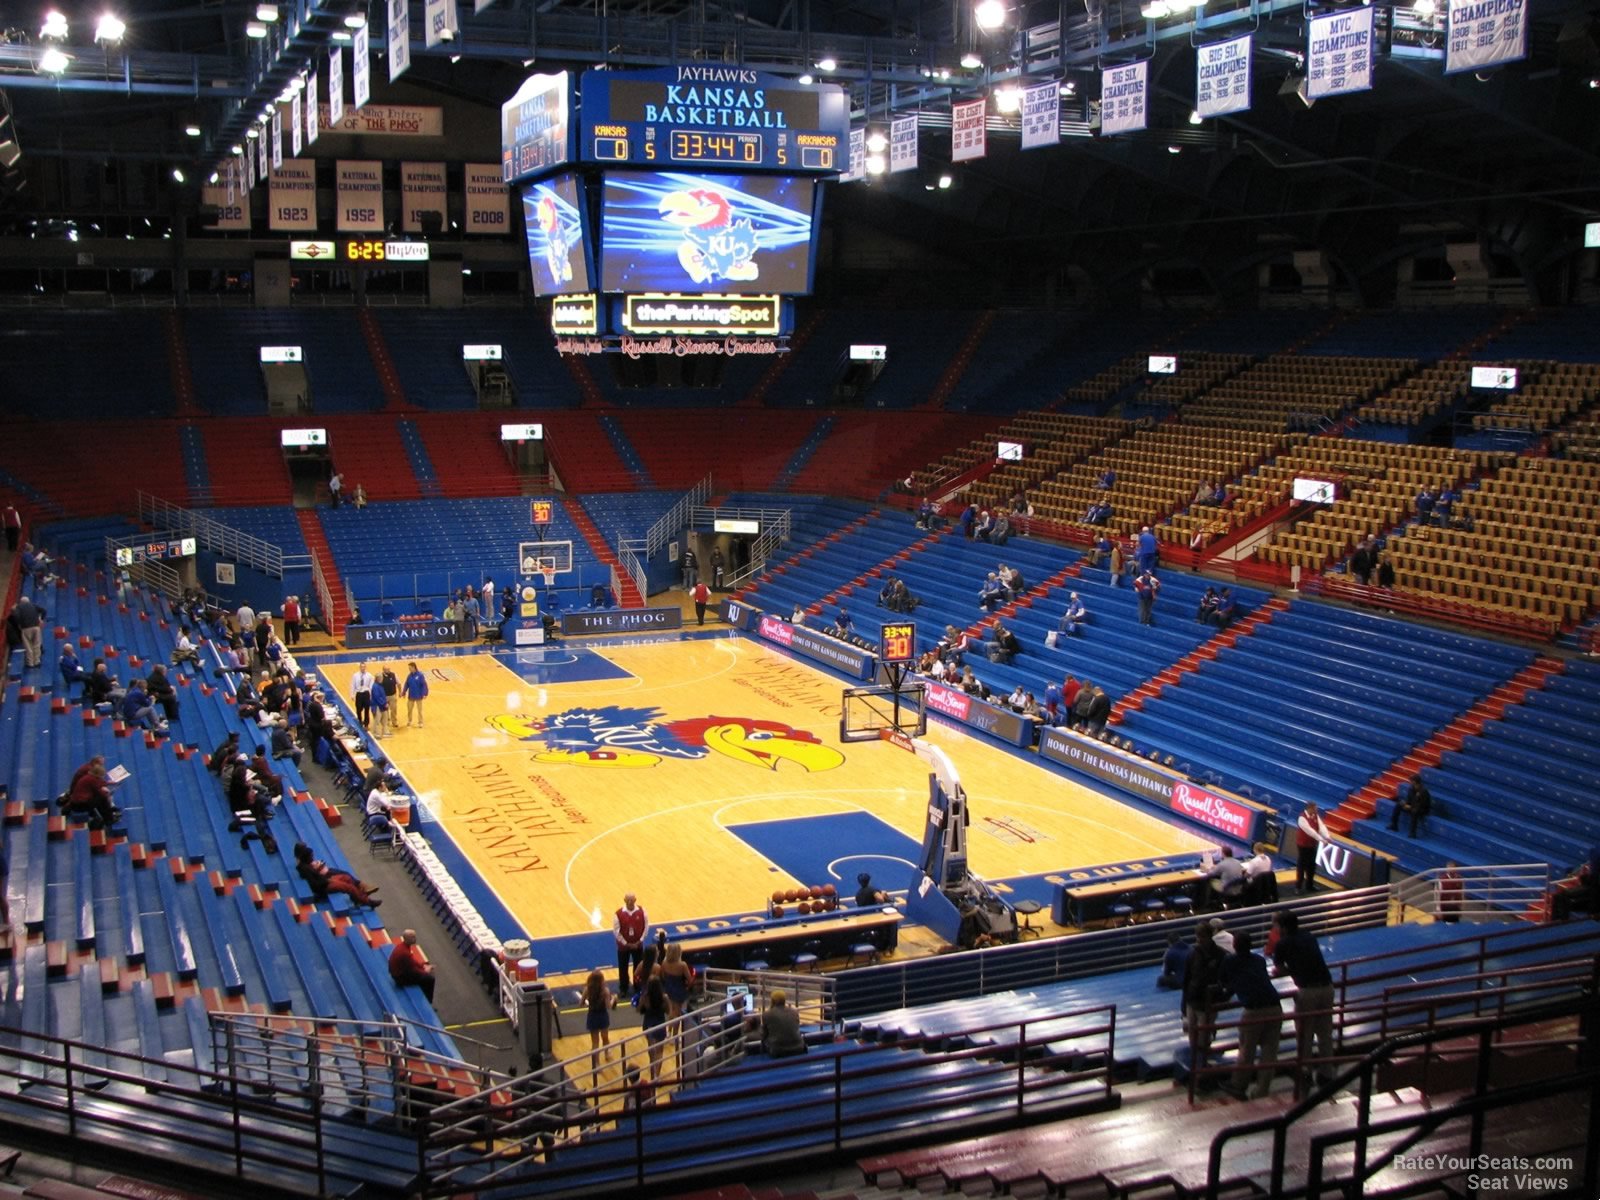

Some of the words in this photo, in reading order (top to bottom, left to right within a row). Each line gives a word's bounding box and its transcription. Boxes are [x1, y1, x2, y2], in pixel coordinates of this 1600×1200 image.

[1330, 16, 1352, 34] MVC
[1312, 30, 1368, 55] CHAMPIONS
[1209, 48, 1222, 62] BIG
[1225, 44, 1238, 59] SIX
[677, 66, 758, 84] JAYHAWKS
[1112, 71, 1123, 84] BIG
[1125, 68, 1136, 81] SIX
[1200, 56, 1246, 79] CHAMPIONS
[667, 85, 765, 109] KANSAS
[1104, 80, 1144, 99] CHAMPIONS
[1024, 98, 1057, 116] CHAMPIONS
[344, 118, 359, 129] OF
[645, 105, 787, 129] BASKETBALL
[594, 125, 627, 137] KANSAS
[738, 135, 758, 144] PERIOD
[615, 140, 626, 159] 0
[677, 134, 734, 157] 33:44
[797, 134, 837, 147] ARKANSAS
[744, 143, 756, 161] 0
[821, 149, 831, 167] 0
[342, 171, 377, 180] NATIONAL
[407, 172, 442, 181] NATIONAL
[270, 182, 314, 190] CHAMPIONS
[338, 183, 382, 191] CHAMPIONS
[403, 184, 446, 192] CHAMPIONS
[467, 186, 509, 194] CHAMPIONS
[278, 207, 308, 221] 1923
[346, 208, 375, 222] 1952
[473, 210, 504, 224] 2008
[348, 242, 385, 259] 6:25
[708, 236, 735, 257] KU
[621, 335, 674, 359] Russell
[674, 335, 723, 357] Stover
[724, 335, 777, 357] Candies
[535, 510, 548, 521] 30
[582, 616, 613, 626] THE
[622, 613, 665, 625] PHOG
[728, 604, 740, 622] KU
[884, 627, 911, 638] 33:44
[791, 634, 804, 646] HOME
[804, 639, 811, 648] OF
[811, 641, 820, 652] THE
[820, 645, 837, 660] KANSAS
[837, 652, 862, 669] JAYHAWKS
[888, 638, 908, 658] 30
[589, 724, 660, 746] KU
[1047, 738, 1069, 755] HOME
[1070, 747, 1081, 759] OF
[1082, 751, 1098, 767] THE
[1099, 758, 1128, 779] KANSAS
[1129, 771, 1173, 798] JAYHAWKS
[462, 762, 579, 839] JAYHAWKS
[1176, 784, 1213, 815] Russell
[1211, 798, 1244, 828] Stover
[1194, 811, 1238, 835] CANDIES
[453, 807, 549, 874] KANSAS
[1315, 840, 1352, 876] KU
